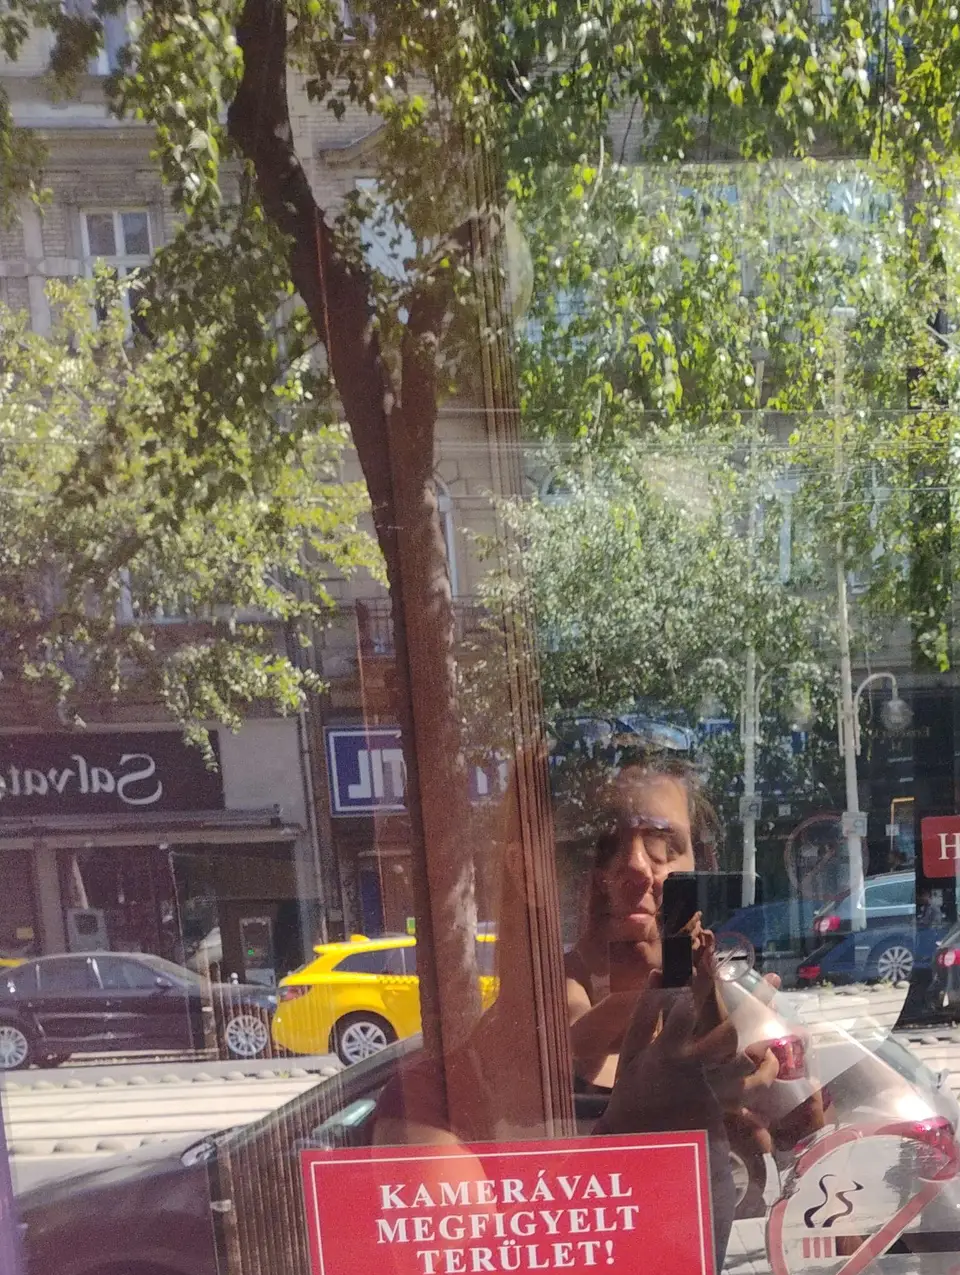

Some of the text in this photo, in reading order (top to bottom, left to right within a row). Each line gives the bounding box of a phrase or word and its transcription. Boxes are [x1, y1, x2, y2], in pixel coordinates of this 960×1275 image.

[379, 1170, 633, 1210] KAMERÁVAL
[375, 1205, 640, 1244] MEGFIGYELT
[417, 1239, 615, 1275] TERÜLET!
